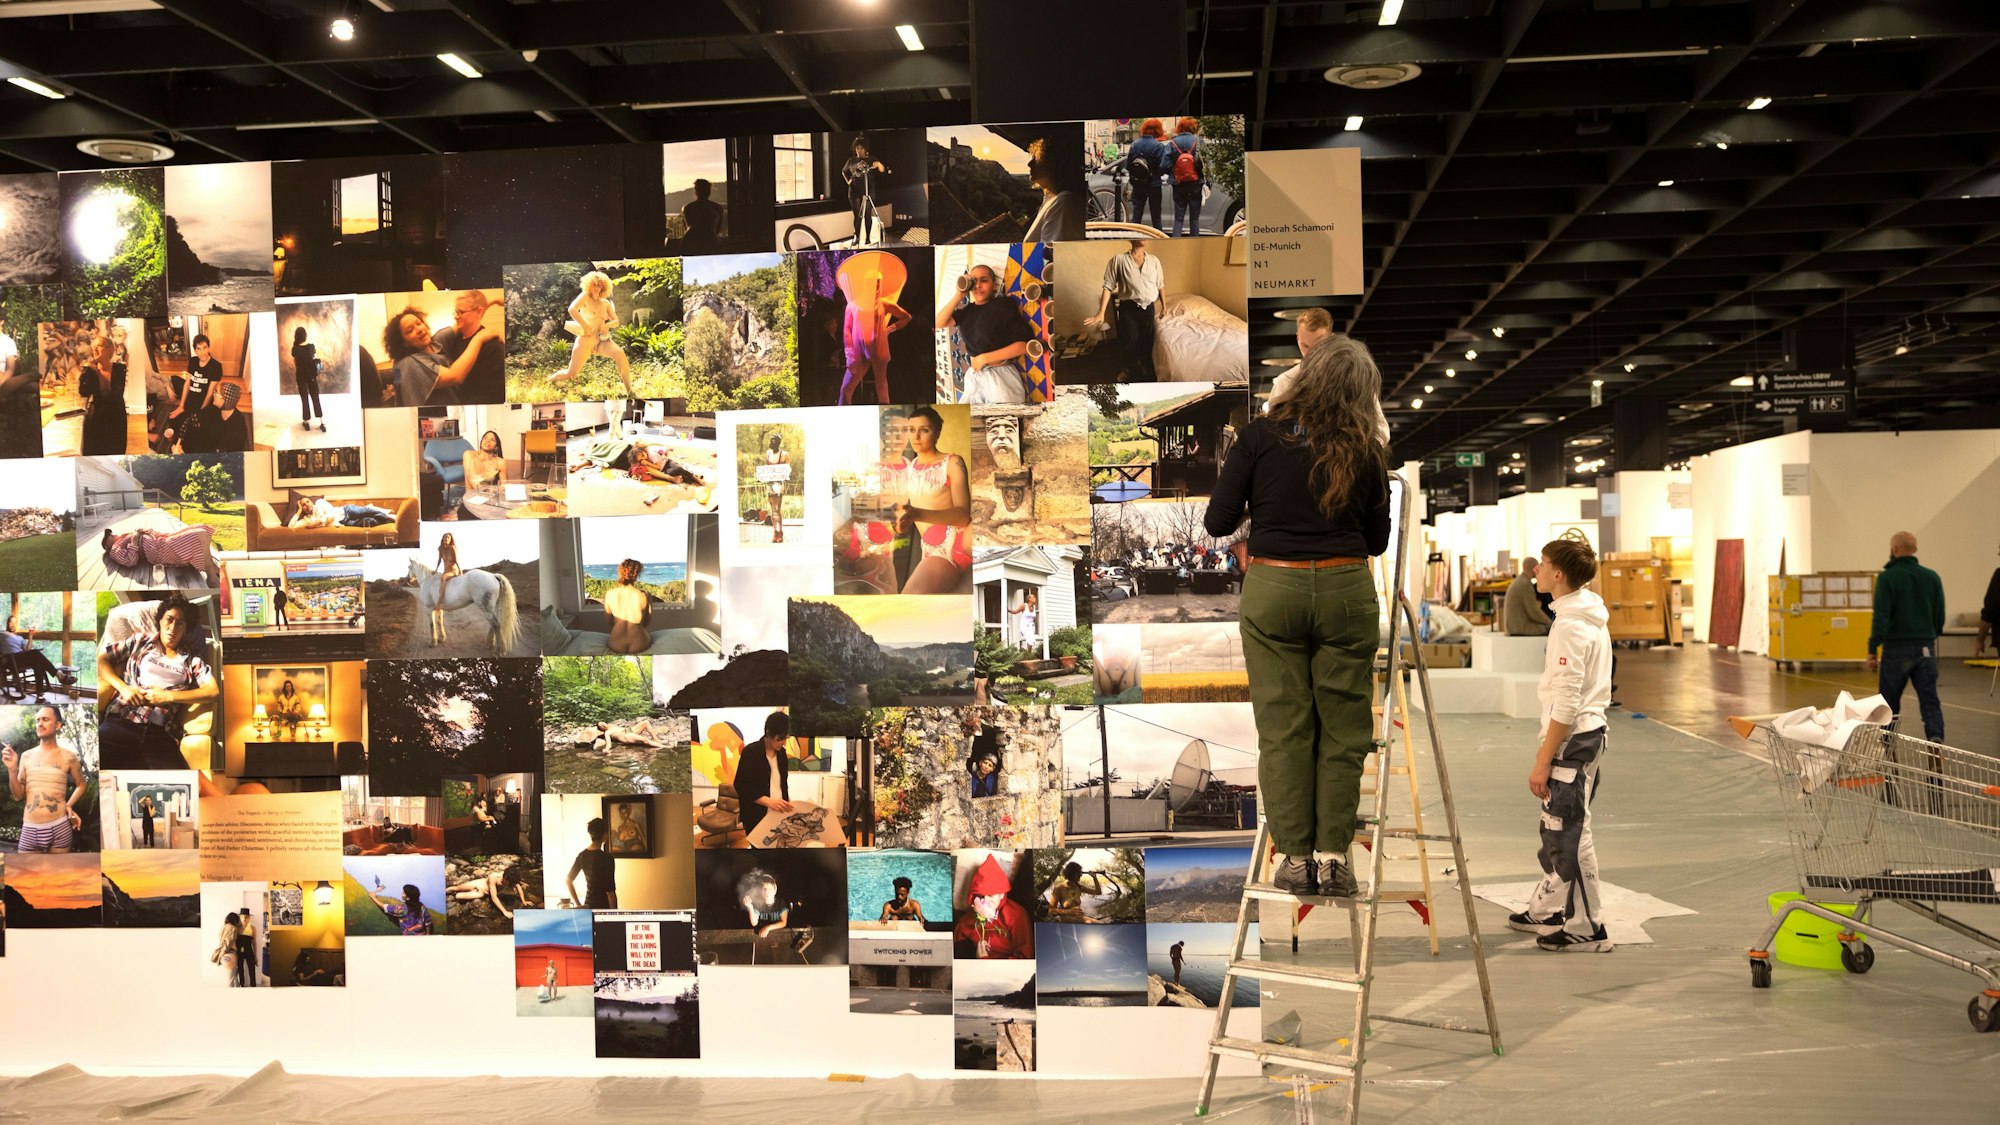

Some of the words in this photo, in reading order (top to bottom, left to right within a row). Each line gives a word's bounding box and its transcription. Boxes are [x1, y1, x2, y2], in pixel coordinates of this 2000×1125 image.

[1253, 224, 1290, 234] Deborah
[1292, 222, 1335, 233] Schamoni
[1253, 241, 1301, 252] DE-Munich
[1254, 261, 1262, 269] N
[1254, 279, 1316, 289] NEUMARKT
